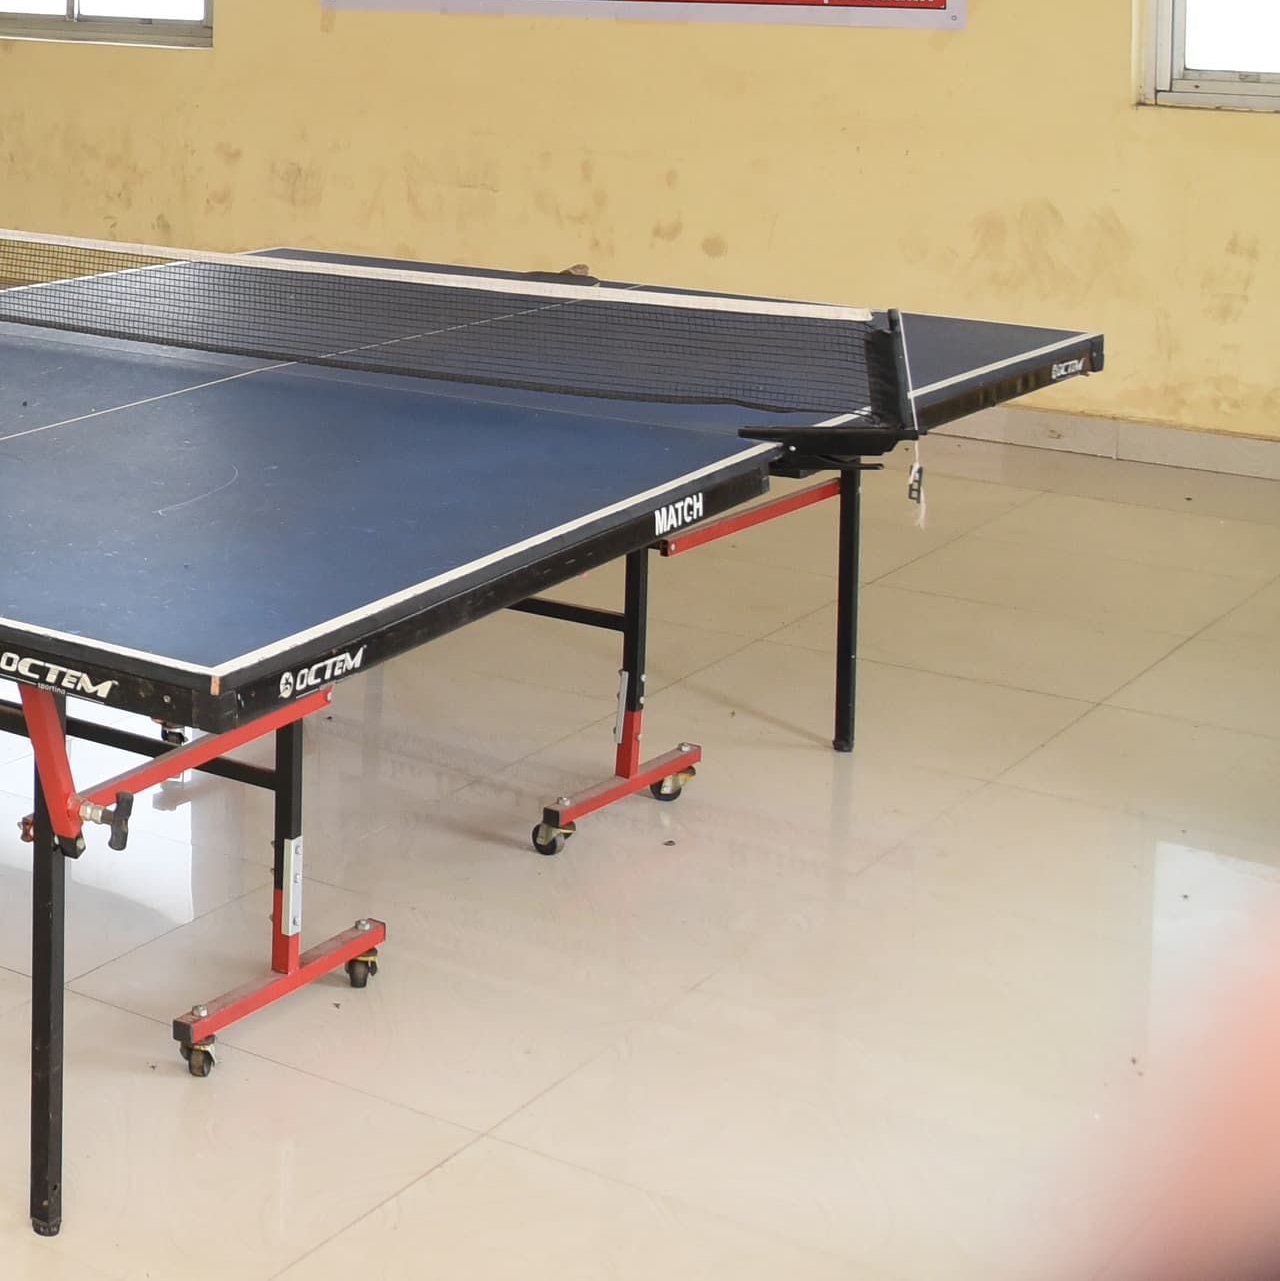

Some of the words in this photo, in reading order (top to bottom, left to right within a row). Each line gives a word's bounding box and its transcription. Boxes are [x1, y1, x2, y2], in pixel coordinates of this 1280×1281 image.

[654, 492, 703, 536] MATCH
[0, 651, 115, 699] OCTEM
[296, 646, 364, 691] OCTEM
